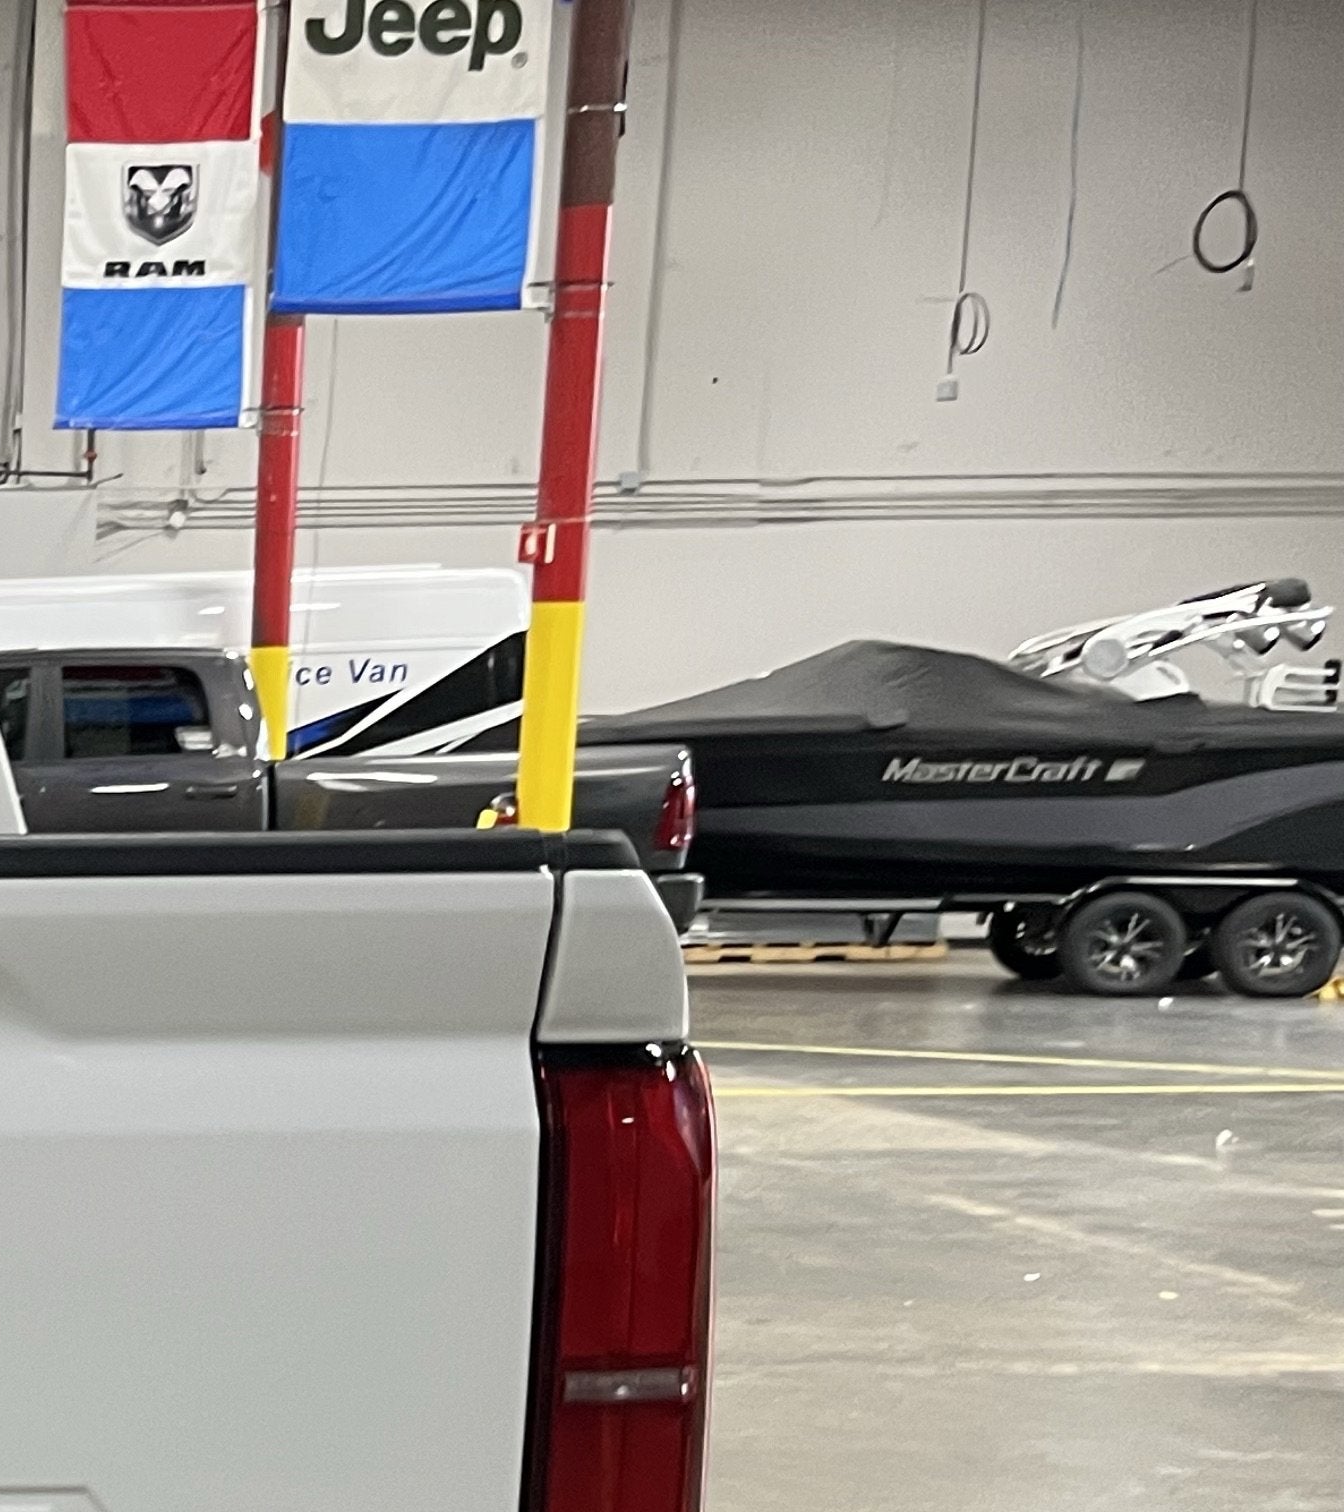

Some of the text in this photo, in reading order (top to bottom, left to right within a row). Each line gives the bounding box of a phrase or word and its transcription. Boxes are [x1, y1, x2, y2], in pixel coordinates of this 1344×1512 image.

[305, 0, 523, 71] Jeep
[103, 259, 207, 279] RAM
[348, 657, 409, 684] Van
[880, 756, 1103, 783] MasterCraft
